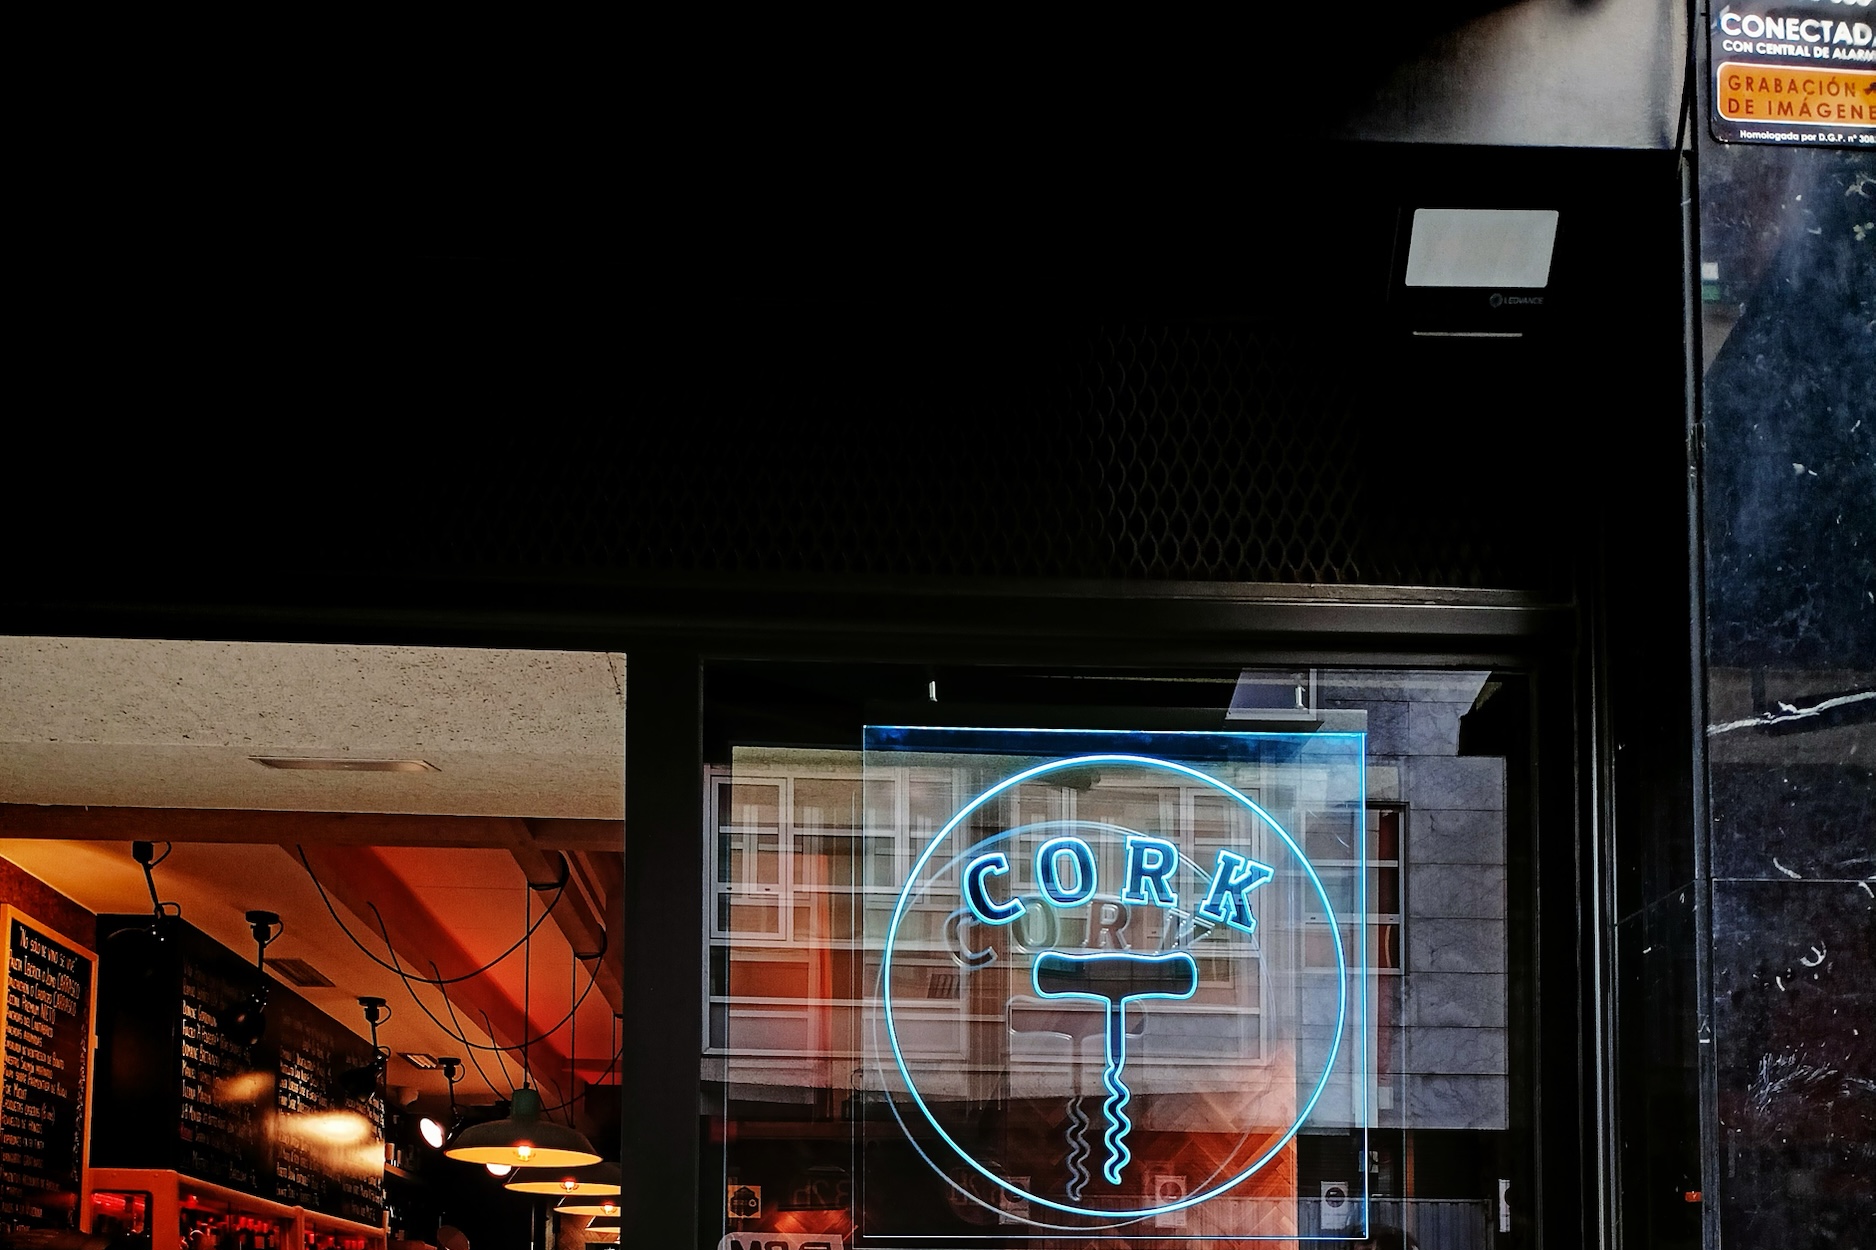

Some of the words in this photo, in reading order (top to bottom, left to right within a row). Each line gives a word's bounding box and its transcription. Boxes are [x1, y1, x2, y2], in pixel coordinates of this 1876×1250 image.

[1720, 13, 1876, 48] CONECTAD
[1722, 40, 1754, 54] CON
[1756, 42, 1811, 58] CENTRAL
[1813, 46, 1830, 59] DE
[1728, 75, 1856, 98] GRABACIÓN
[1728, 98, 1754, 114] DE
[1740, 129, 1800, 142] Homologada
[1801, 133, 1817, 142] por
[962, 836, 1275, 933] CORK
